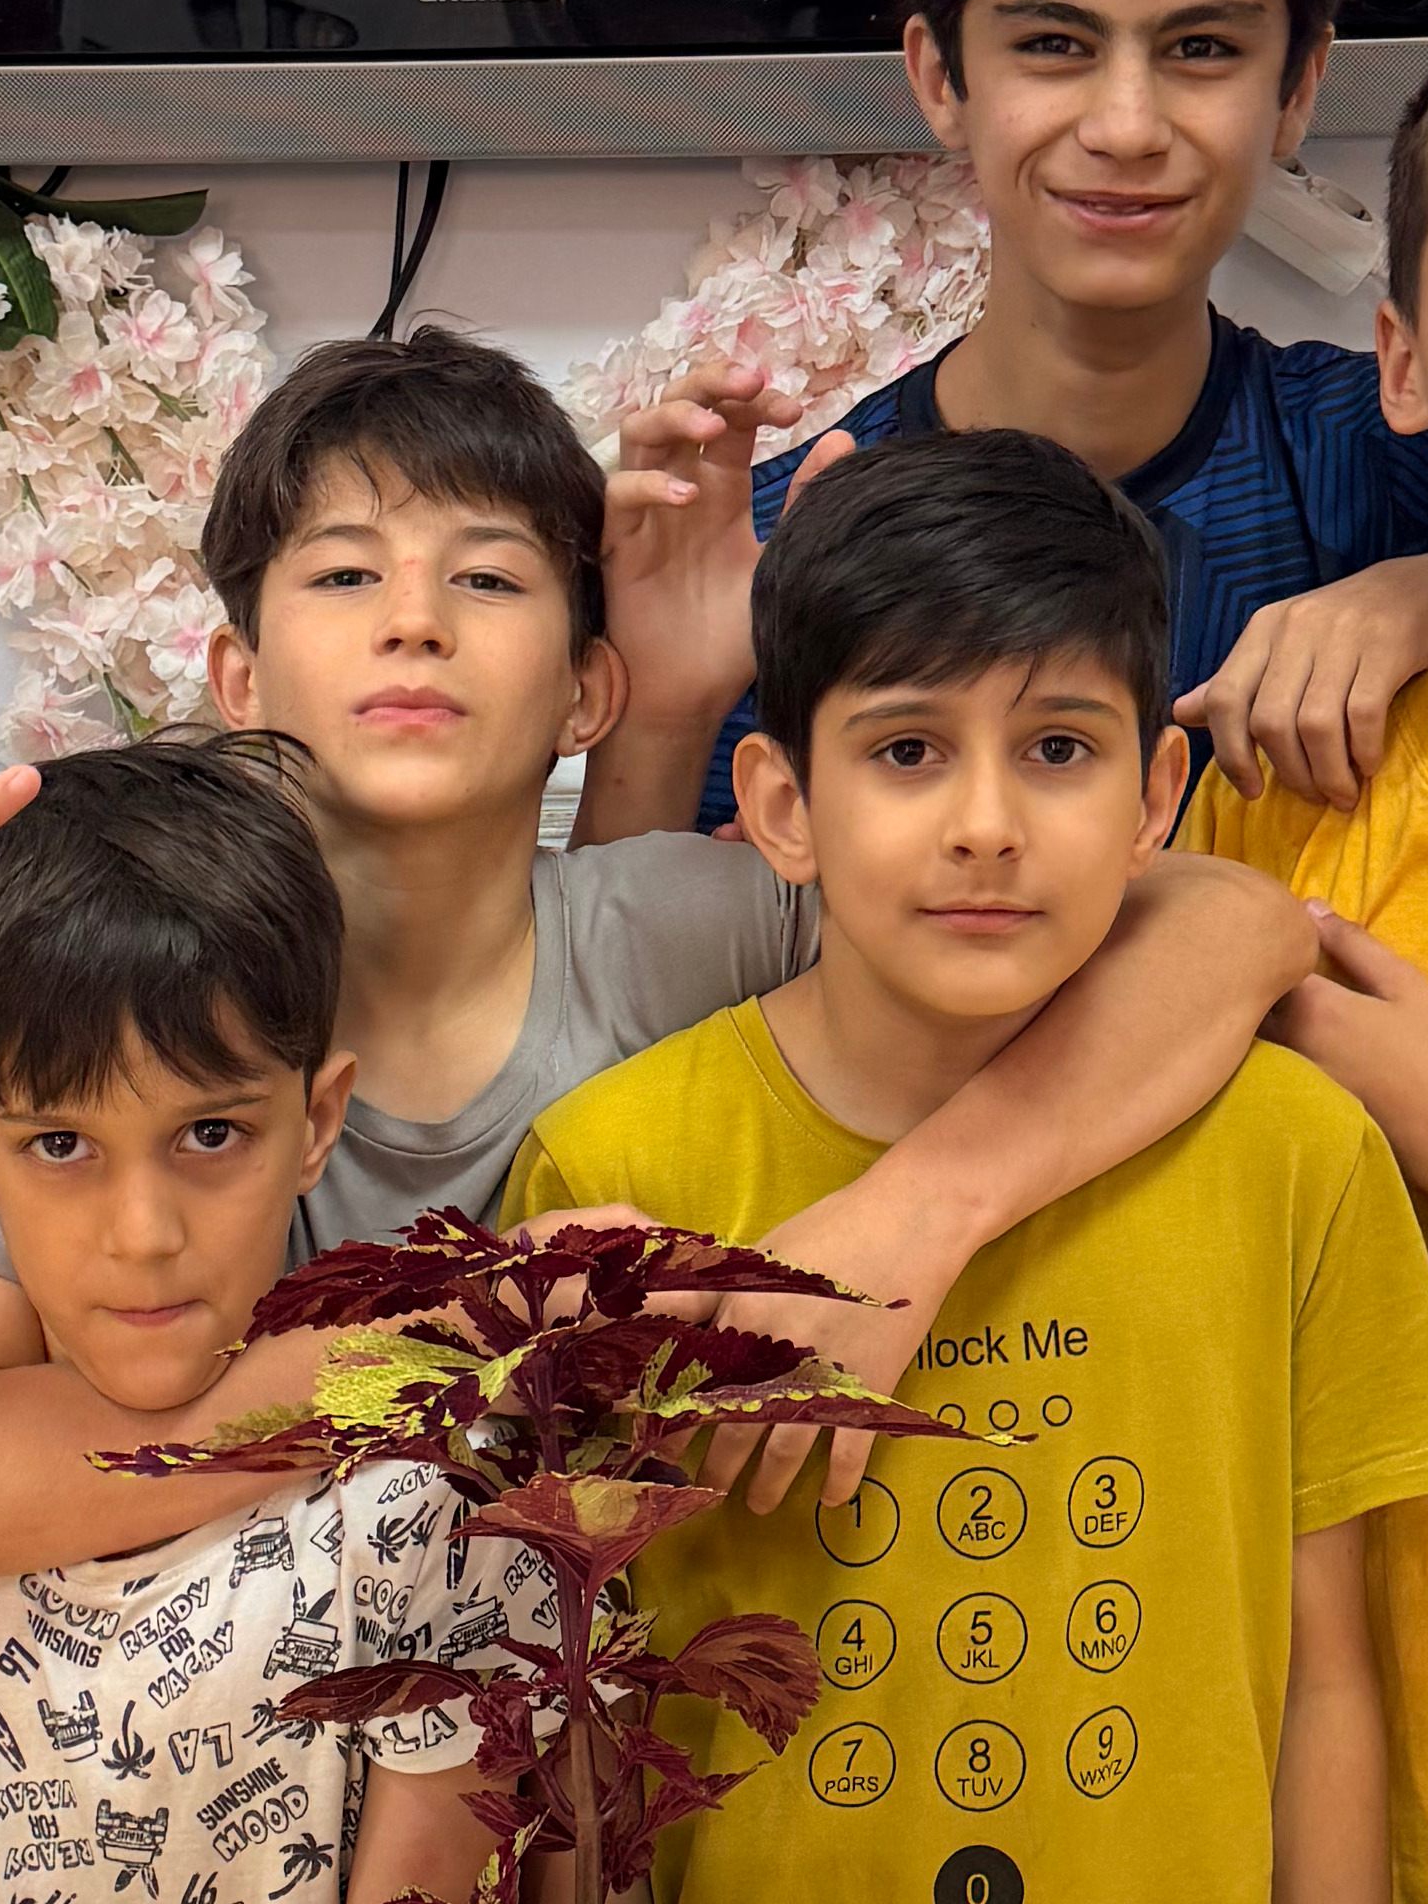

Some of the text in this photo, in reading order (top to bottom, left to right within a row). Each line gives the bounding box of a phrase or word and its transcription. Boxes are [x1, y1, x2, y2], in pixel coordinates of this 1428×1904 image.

[917, 1320, 1089, 1370] lock Me
[970, 1486, 993, 1521] 2
[1095, 1474, 1117, 1509] 3
[848, 1493, 862, 1528] 1
[1084, 1512, 1129, 1535] DEF
[958, 1522, 1006, 1542] ABC
[119, 1576, 210, 1661] READY
[970, 1610, 993, 1646] 5
[1095, 1599, 1117, 1634] 6
[159, 1627, 195, 1664] FOR
[398, 1622, 432, 1660] 97
[841, 1618, 866, 1651] 4
[1081, 1635, 1127, 1660] MNO
[148, 1620, 234, 1709] VACAY
[835, 1655, 873, 1675] GHI
[961, 1649, 1000, 1669] JKL
[382, 1705, 459, 1753] LA
[1098, 1725, 1114, 1760] 9
[168, 1721, 234, 1775] LA
[842, 1738, 863, 1772] 7
[969, 1738, 991, 1773] 8
[824, 1776, 879, 1795] PQRS
[957, 1777, 1003, 1797] TUV
[1080, 1759, 1122, 1787] WXYZ
[196, 1757, 288, 1831] SUNSHINE
[29, 1814, 59, 1839] FOR
[213, 1784, 309, 1863] MOOD
[4, 1839, 95, 1880] READY
